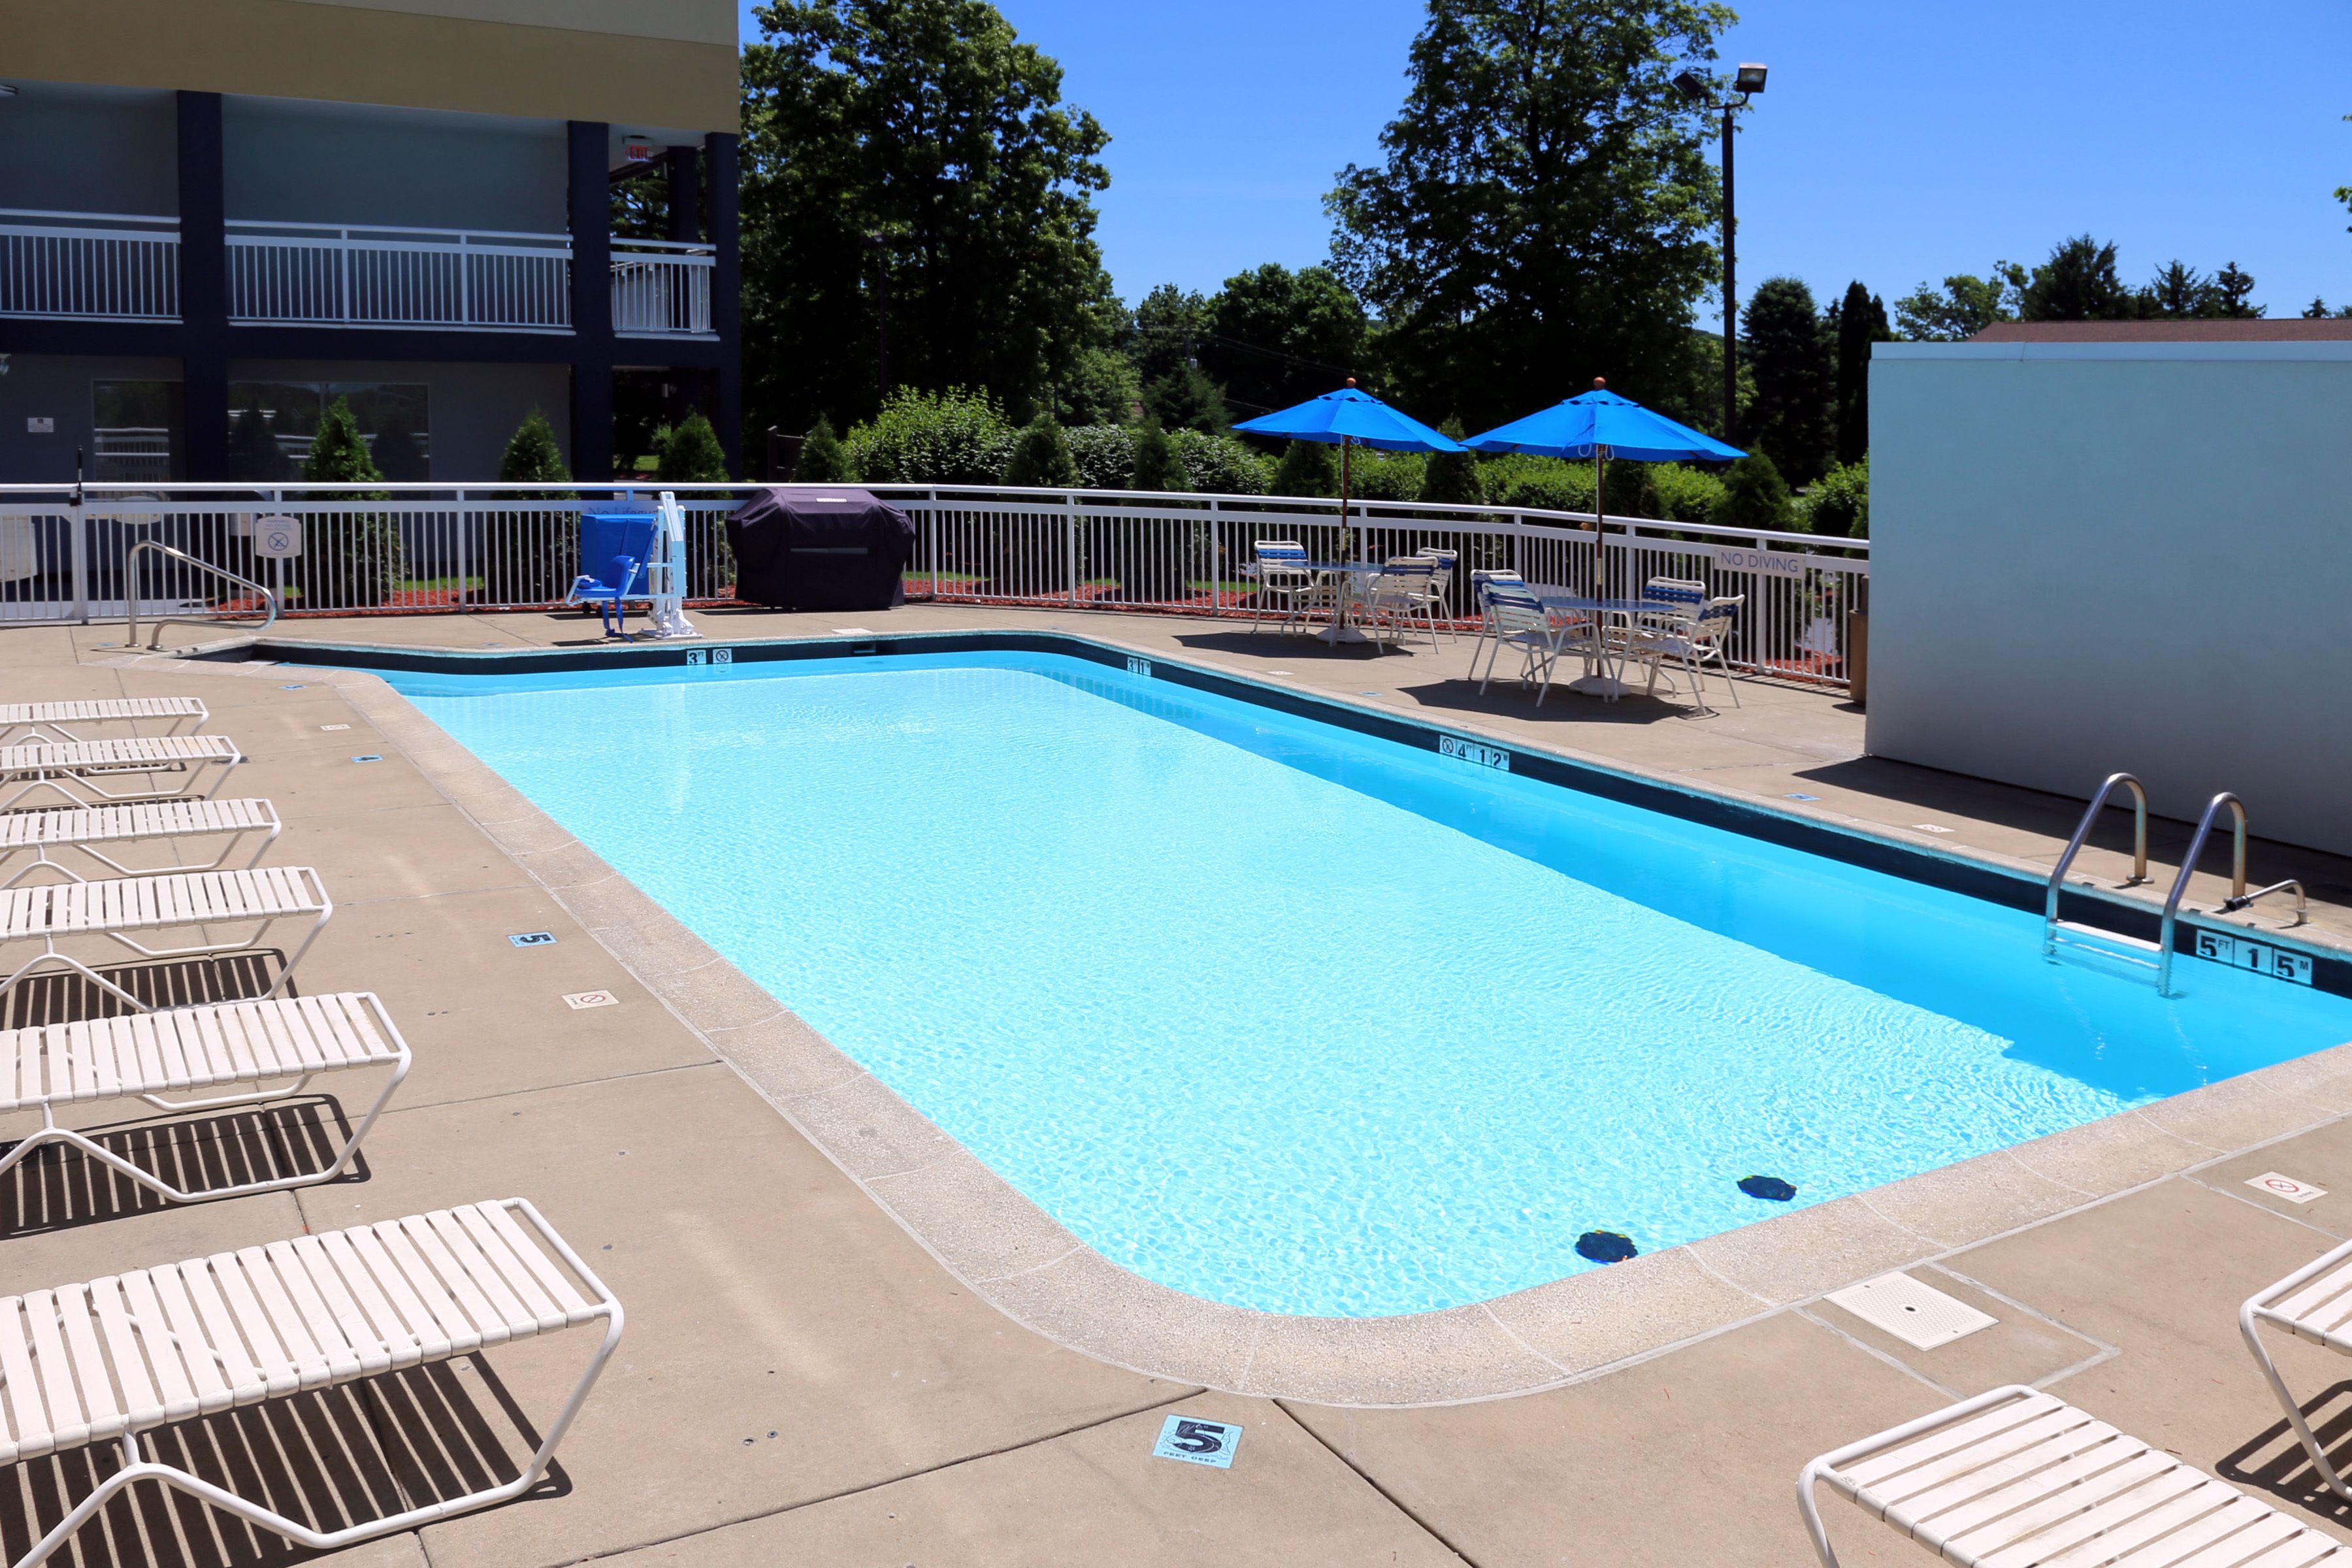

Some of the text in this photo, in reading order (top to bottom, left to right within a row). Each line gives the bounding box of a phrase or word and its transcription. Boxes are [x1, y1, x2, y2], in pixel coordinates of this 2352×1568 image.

[1721, 551, 1798, 572] NO DIVING
[689, 652, 698, 664] 3
[1458, 743, 1466, 758] 4
[2200, 935, 2217, 957] 5
[1173, 1420, 1225, 1454] 5
